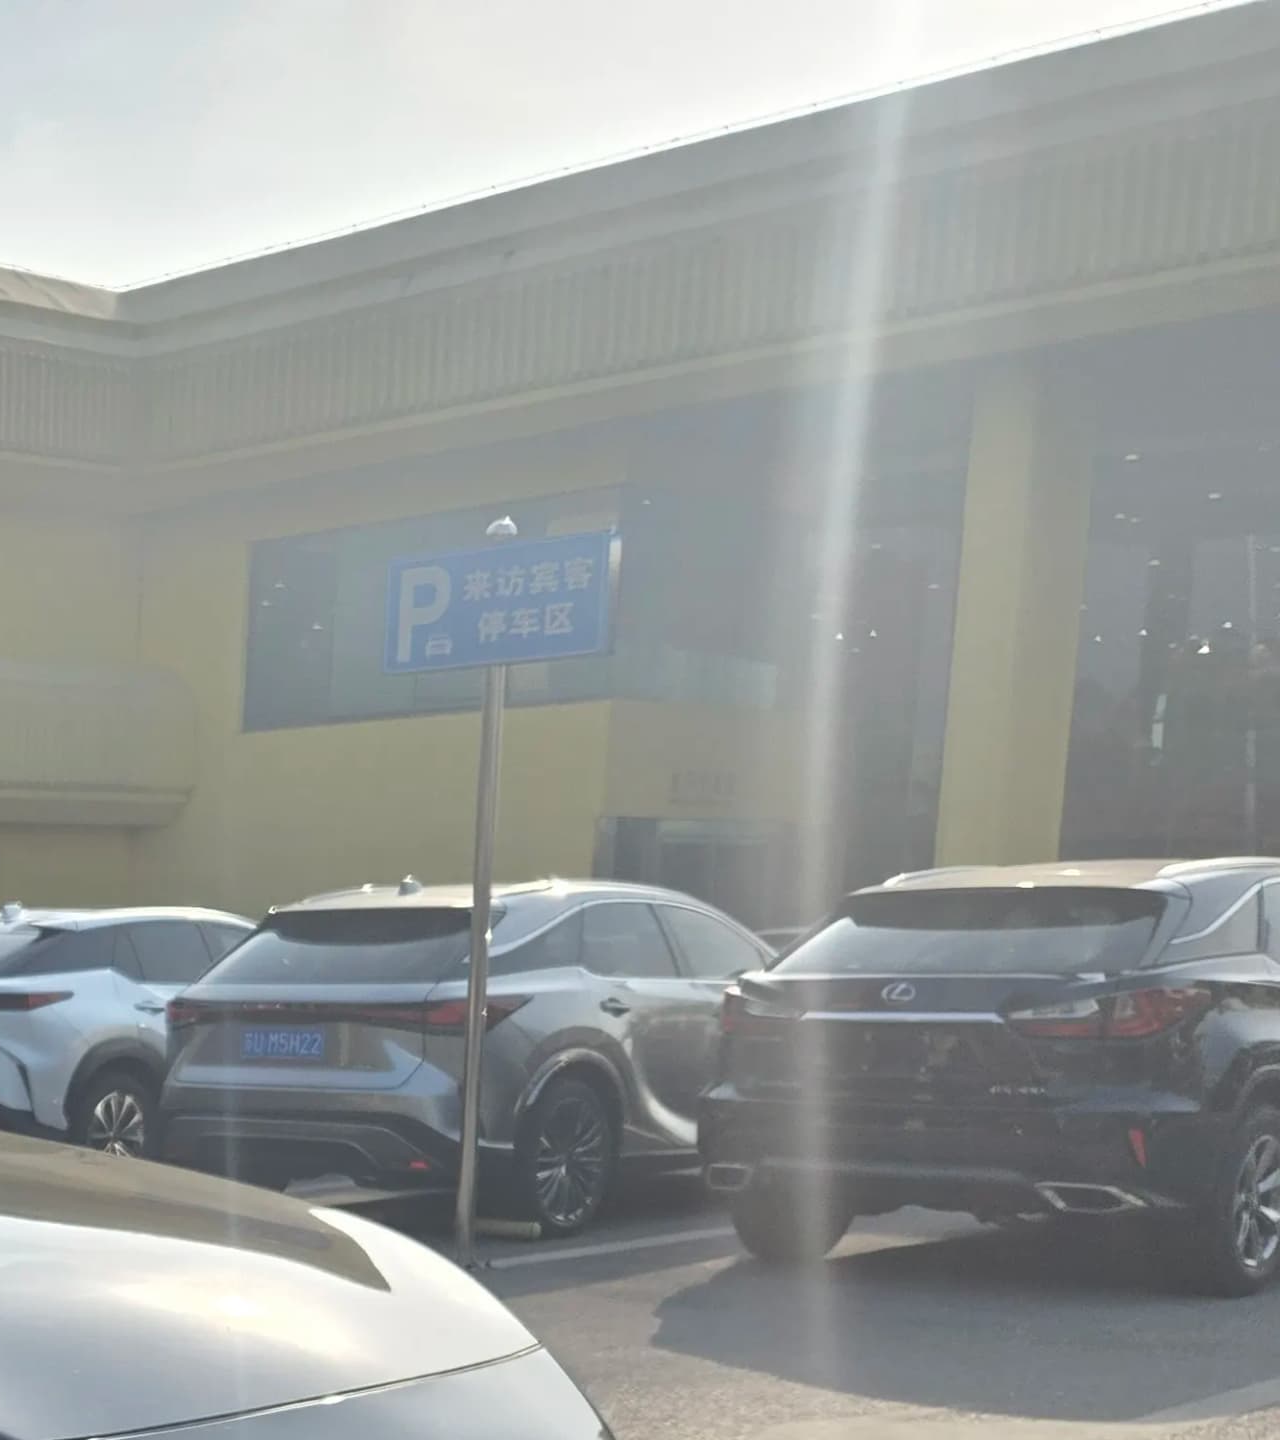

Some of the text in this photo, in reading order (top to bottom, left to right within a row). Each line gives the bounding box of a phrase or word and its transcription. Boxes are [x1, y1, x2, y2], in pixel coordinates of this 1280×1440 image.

[462, 556, 593, 601] 来访宾客
[396, 565, 452, 664] P
[477, 601, 575, 643] 停车区
